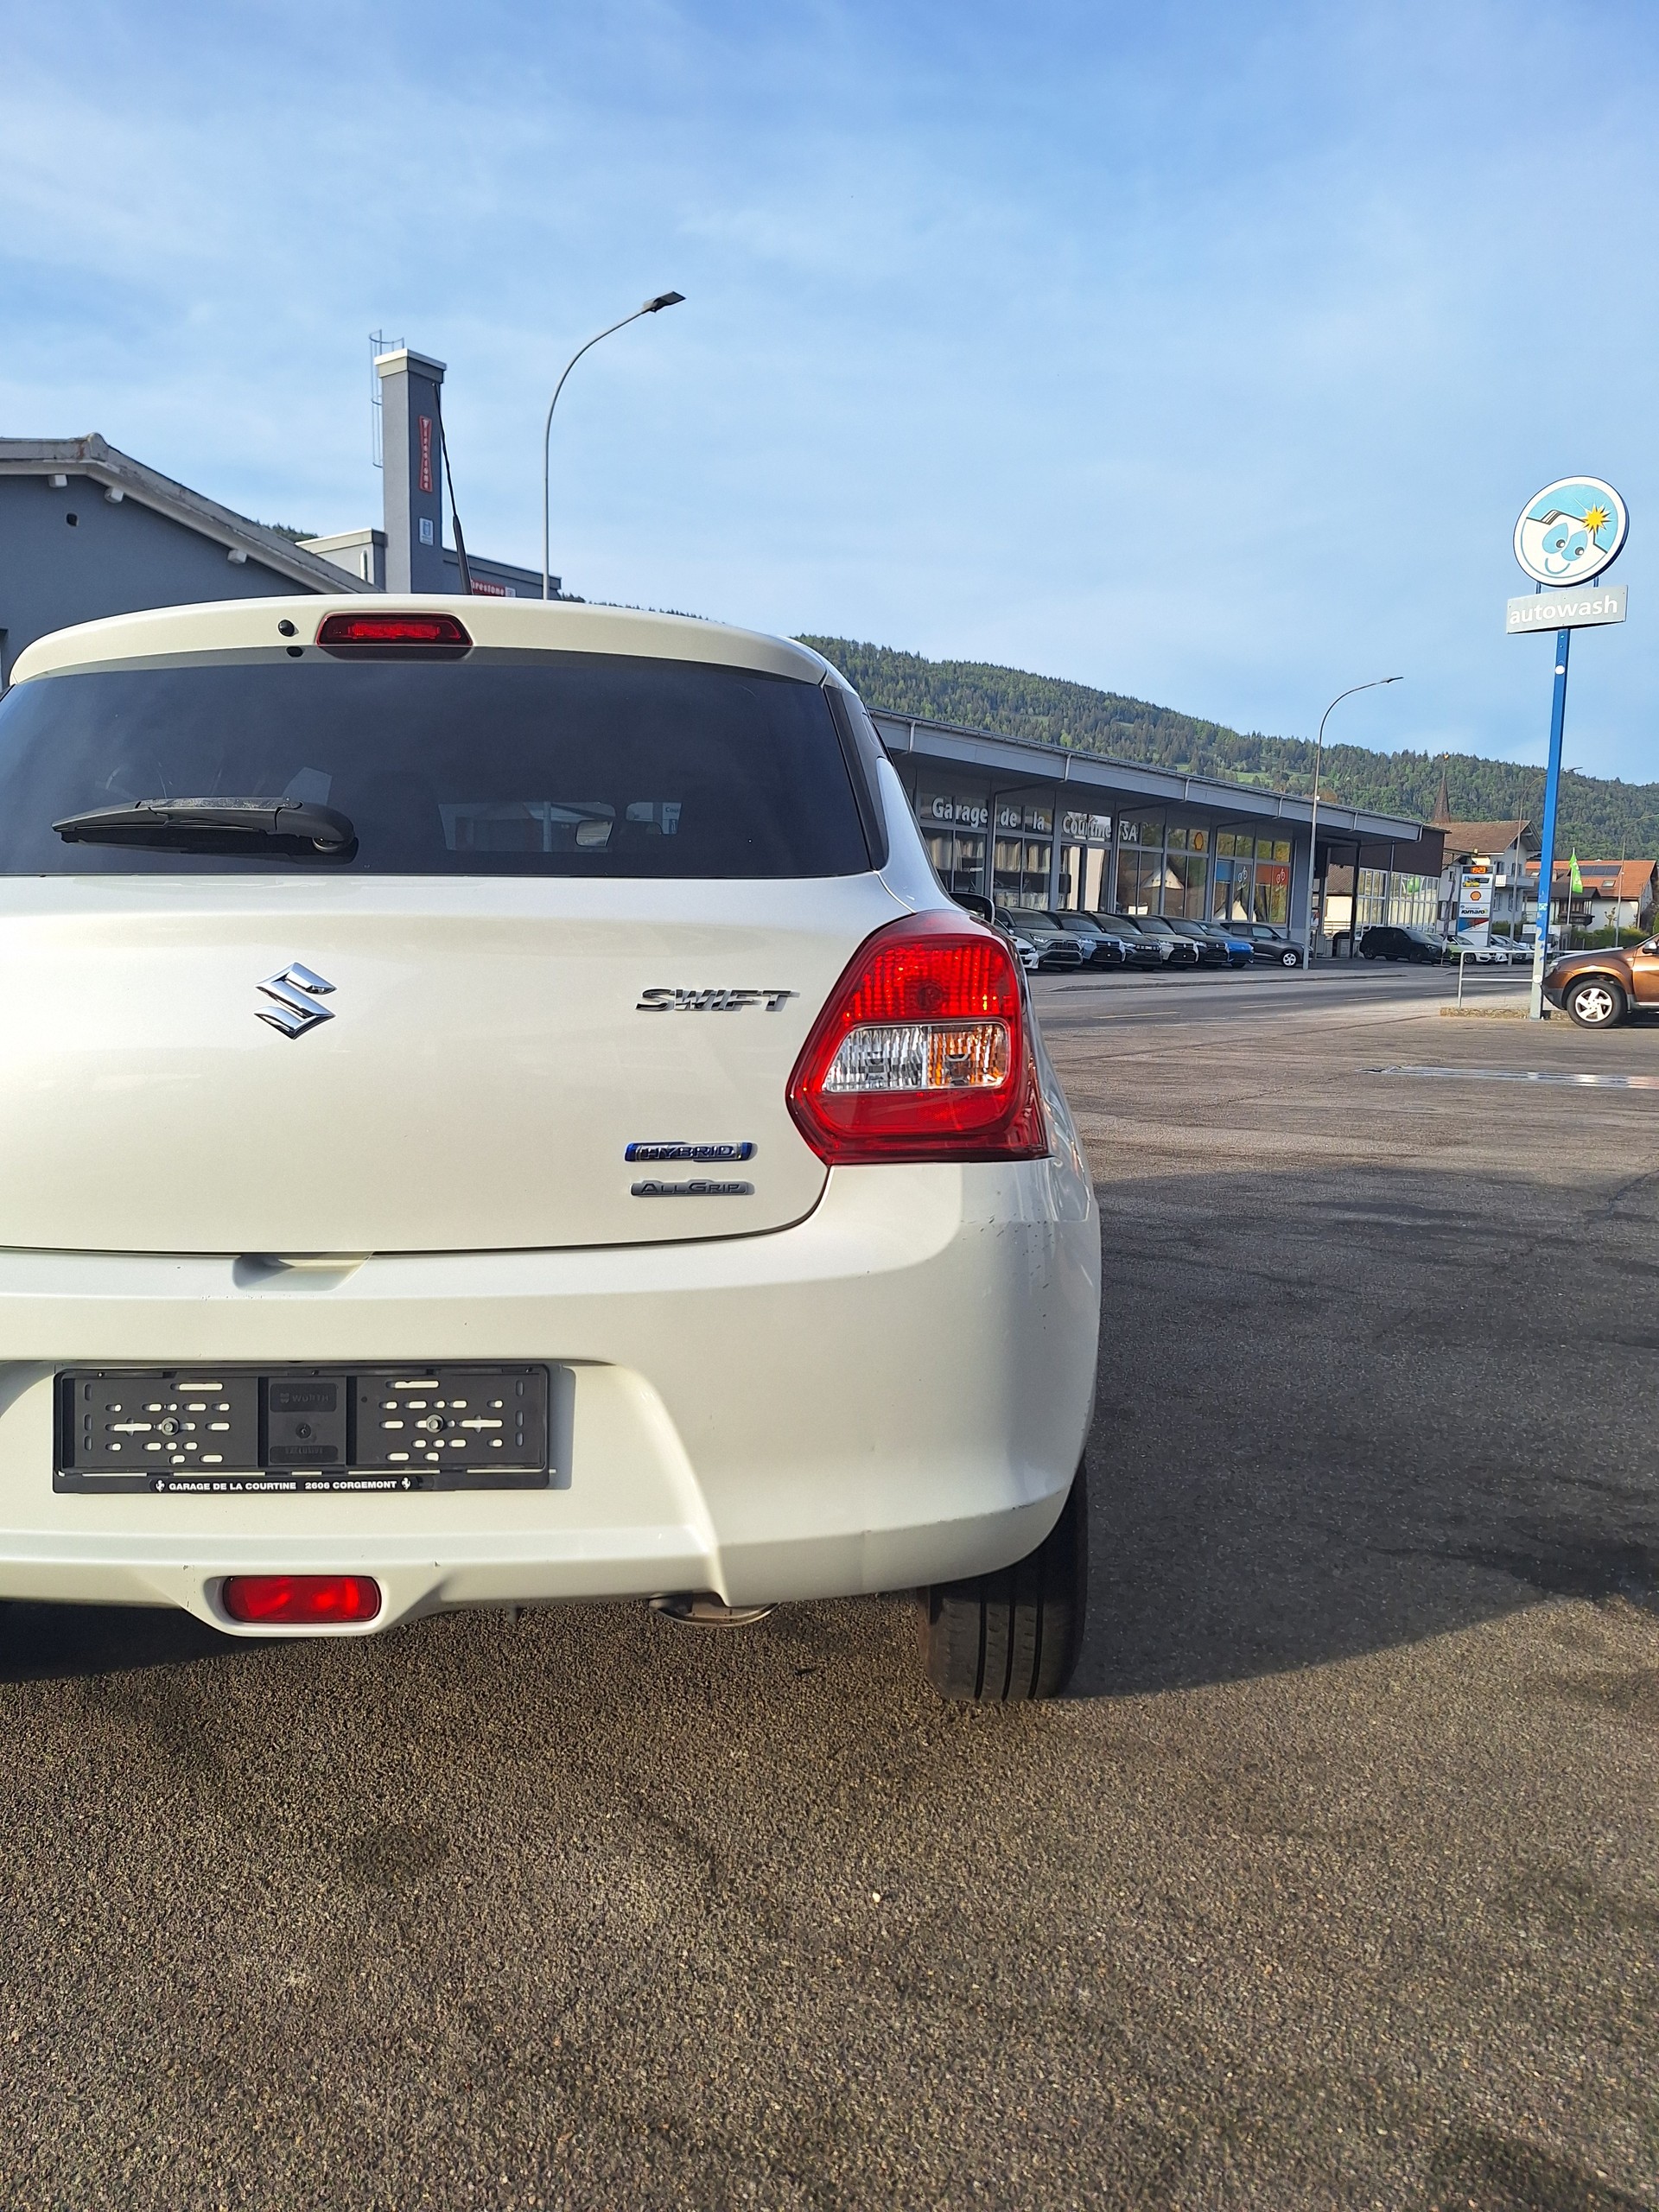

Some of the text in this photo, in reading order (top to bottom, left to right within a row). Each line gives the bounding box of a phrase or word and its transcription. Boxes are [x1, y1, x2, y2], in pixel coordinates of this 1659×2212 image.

[1509, 594, 1618, 624] autowash
[931, 797, 988, 829] Garage
[1000, 807, 1018, 828] de
[1033, 810, 1046, 830] la
[1122, 823, 1137, 842] SA
[635, 988, 791, 1012] SWIFT
[639, 1145, 735, 1159] HYBRID
[168, 1480, 397, 1491] GARAGE DE LA COURTINE 2606 CORGEMONT
